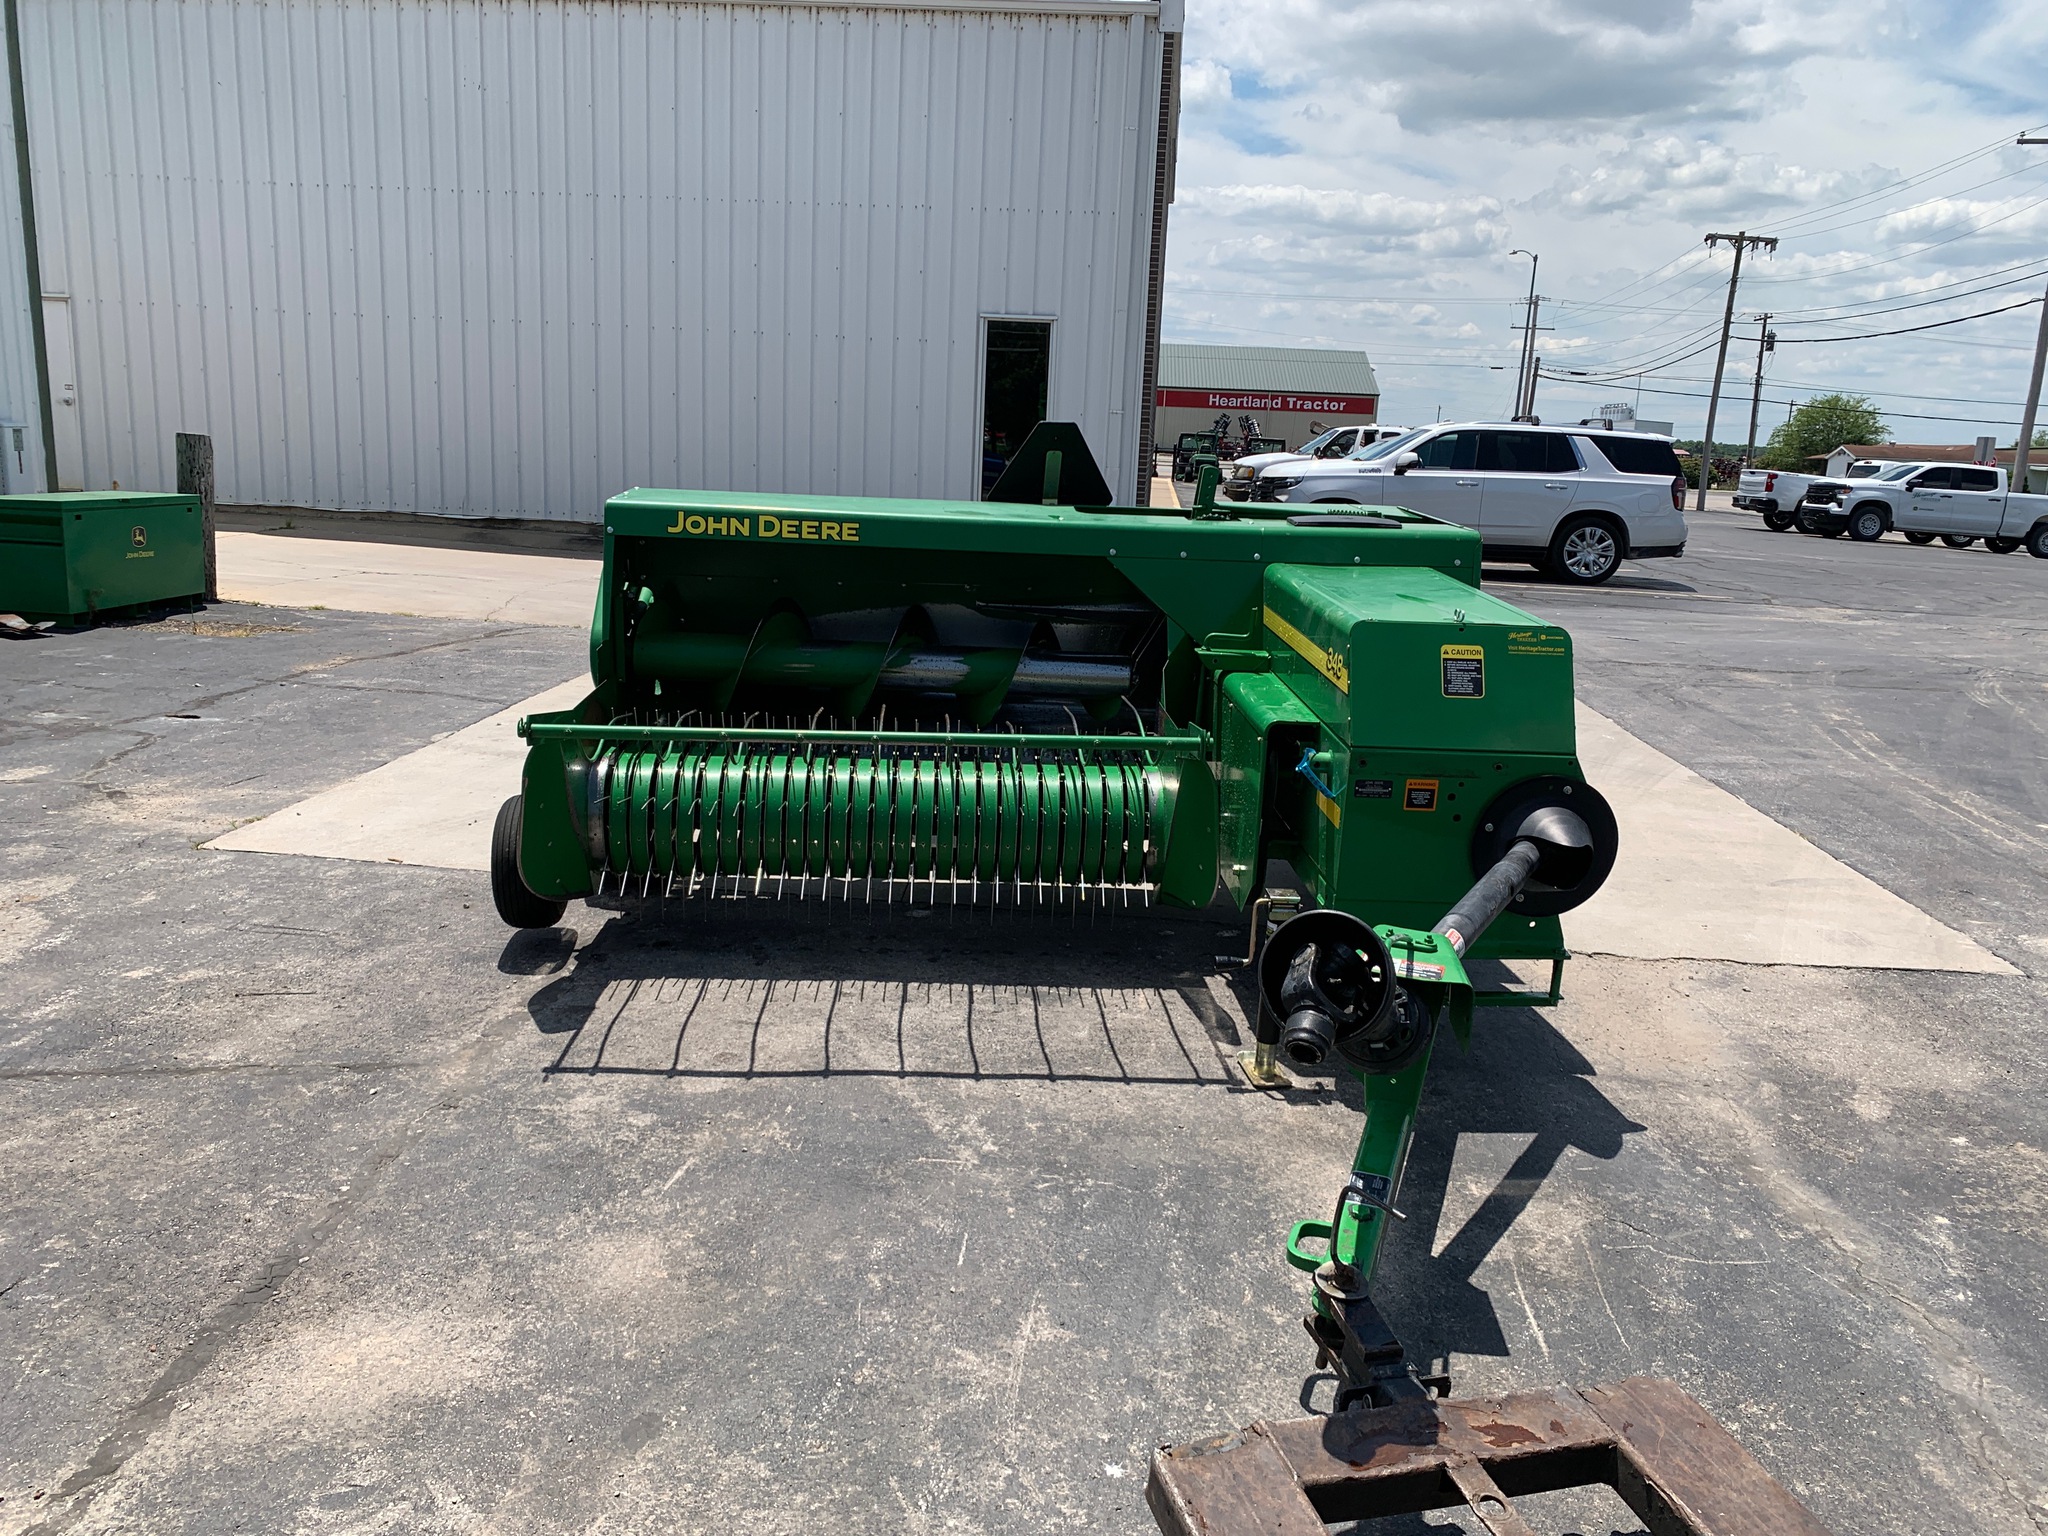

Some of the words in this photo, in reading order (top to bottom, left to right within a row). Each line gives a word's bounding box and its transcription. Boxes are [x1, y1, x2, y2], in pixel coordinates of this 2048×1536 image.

[1208, 394, 1282, 409] Heartland
[1286, 397, 1347, 411] Tractor
[667, 511, 750, 537] JOHN
[758, 515, 860, 542] DEERE
[1325, 646, 1344, 681] 348
[1450, 648, 1482, 656] CAUTION
